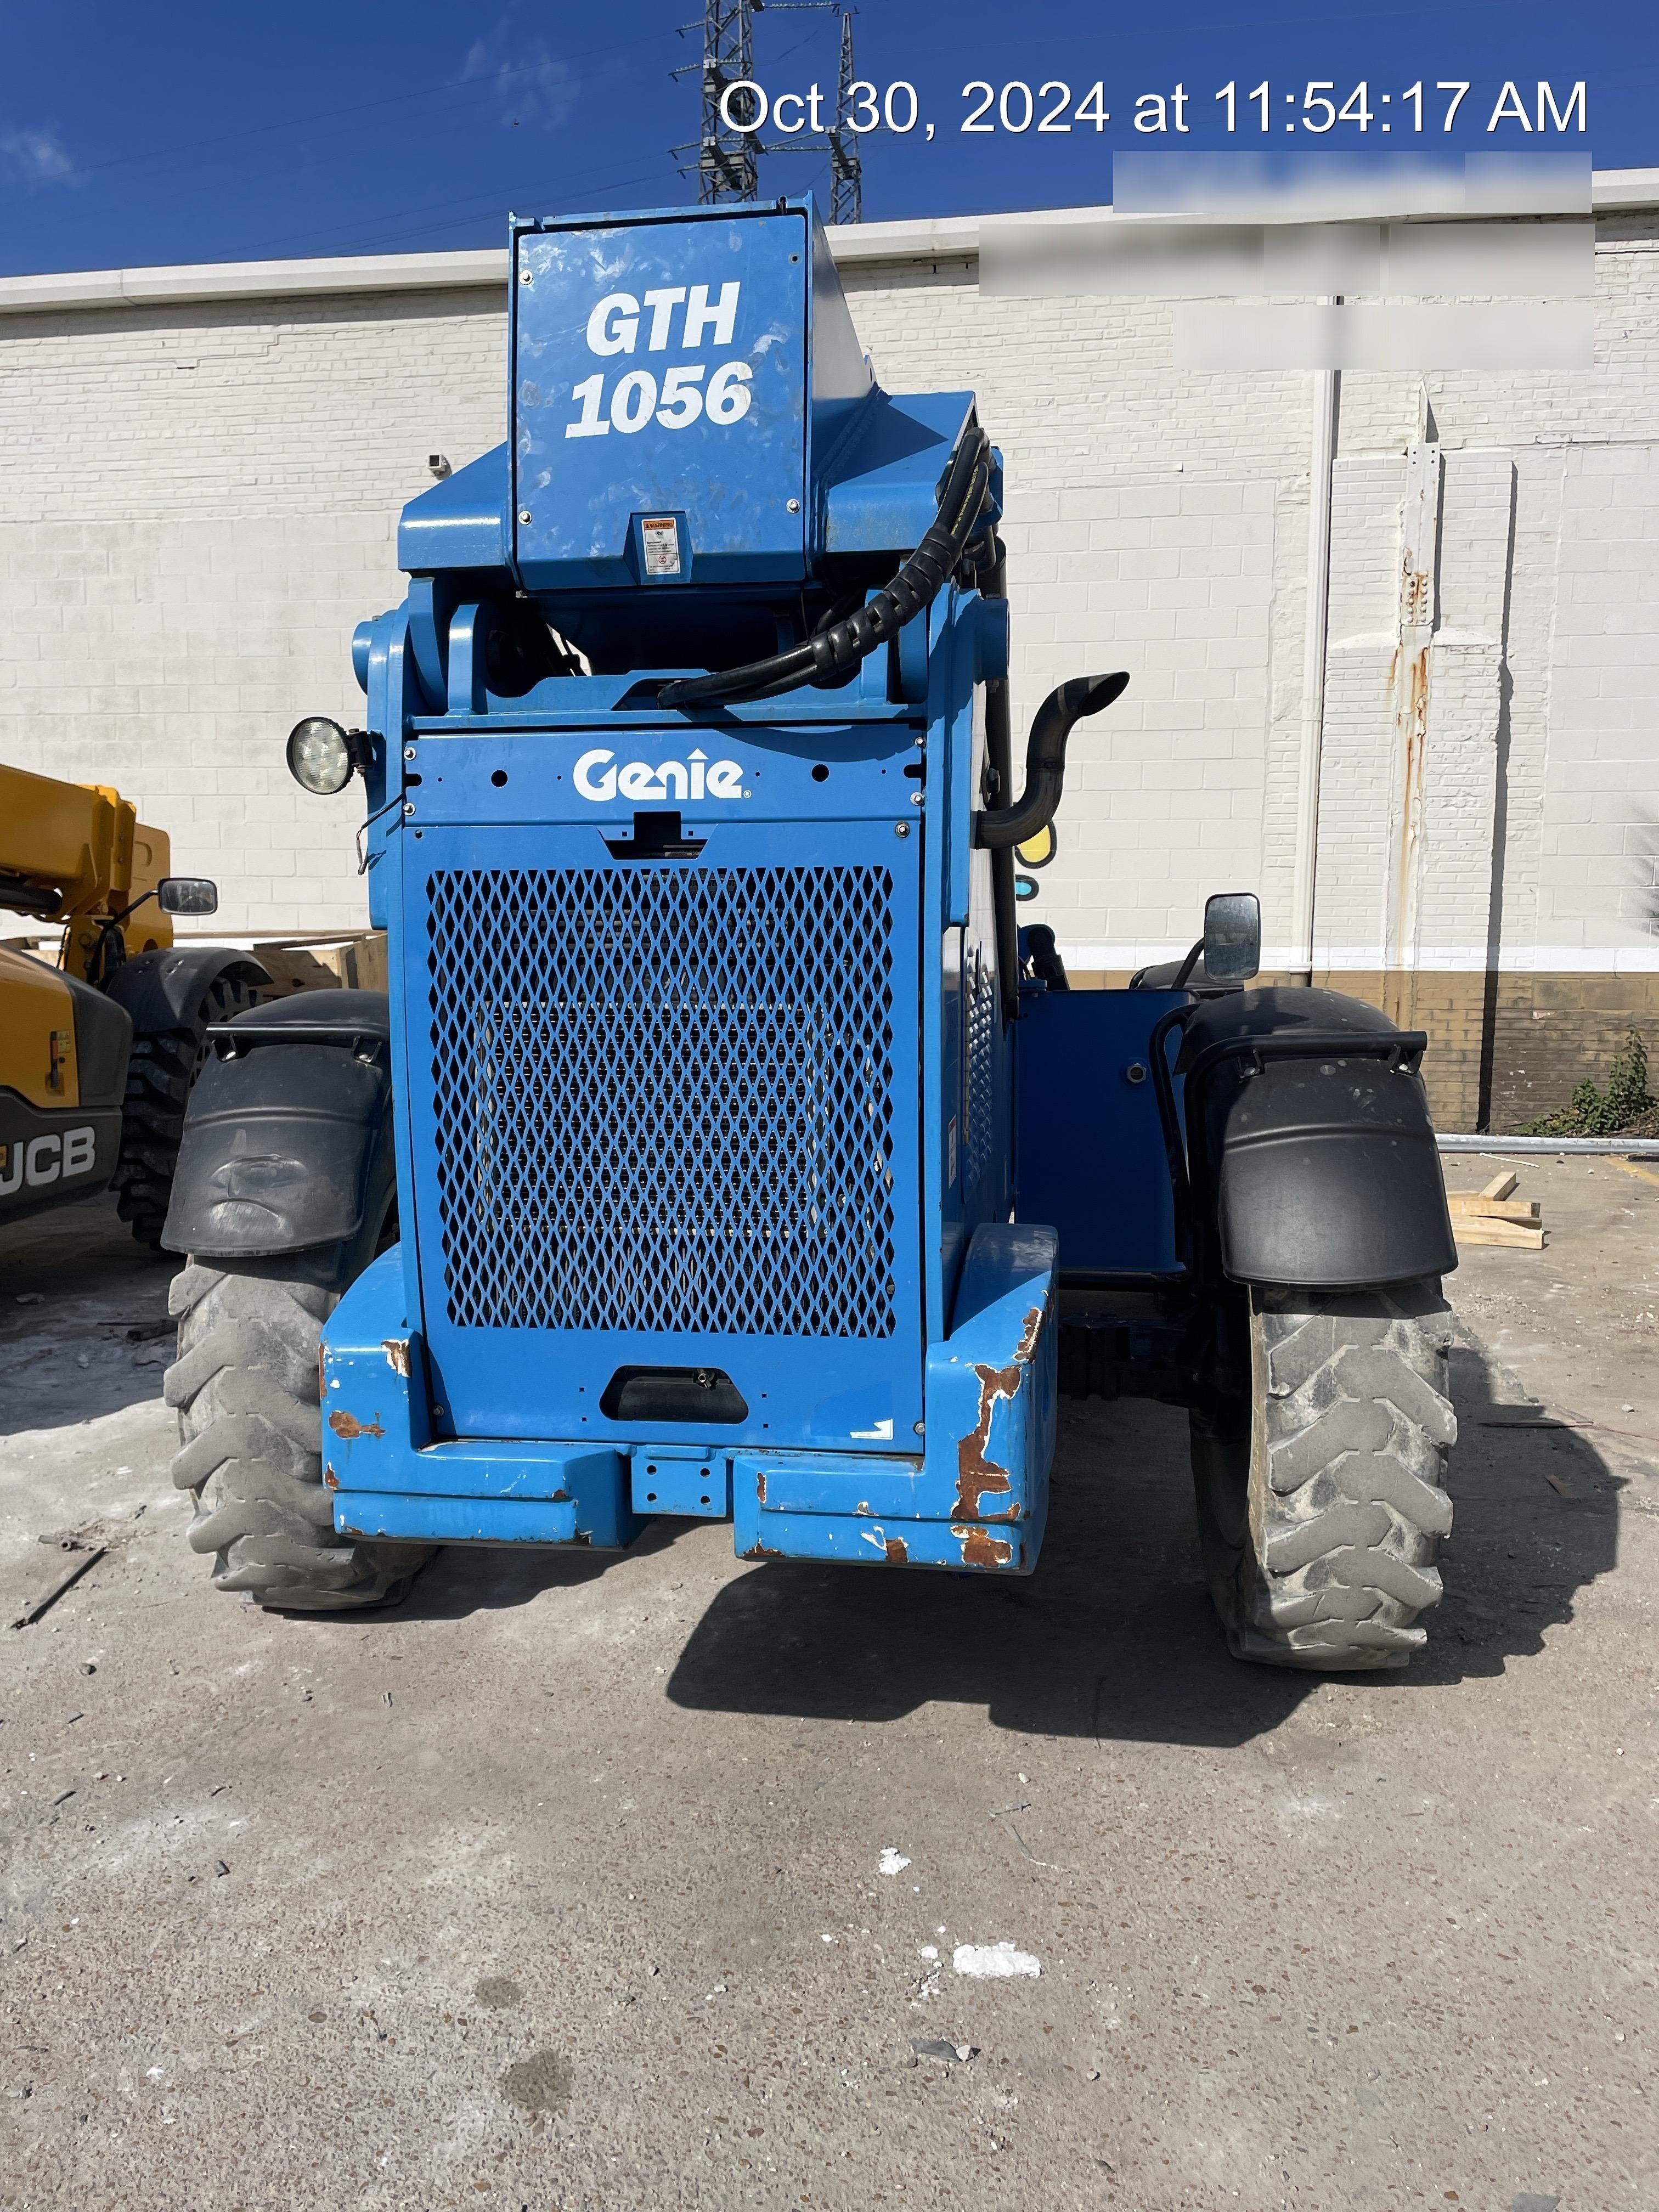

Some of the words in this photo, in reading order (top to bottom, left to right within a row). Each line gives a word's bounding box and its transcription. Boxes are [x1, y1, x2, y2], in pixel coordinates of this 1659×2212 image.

[586, 281, 741, 357] GTH
[565, 361, 753, 438] 1056
[0, 1126, 95, 1195] JCB
